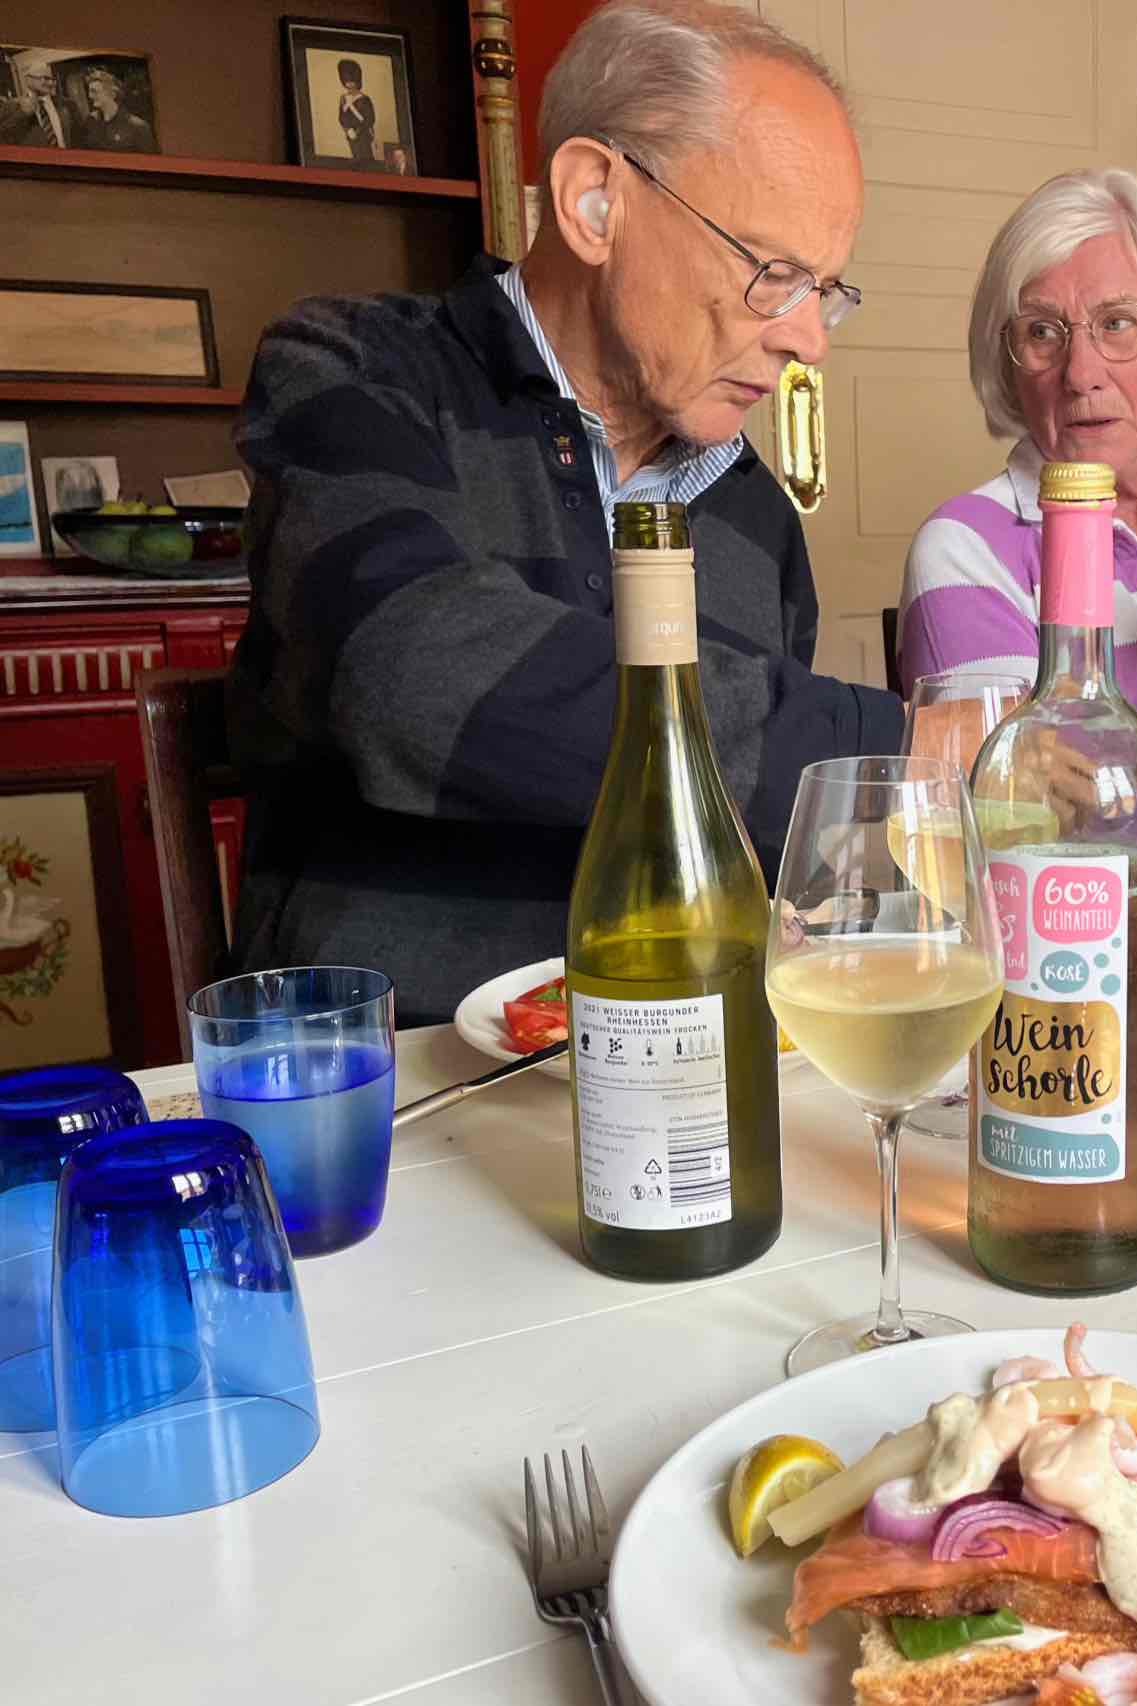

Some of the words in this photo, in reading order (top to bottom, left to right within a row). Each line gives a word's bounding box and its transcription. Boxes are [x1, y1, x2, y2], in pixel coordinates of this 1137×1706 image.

[1044, 878, 1109, 905] 60%
[1042, 907, 1112, 931] WEINANTEIL
[603, 1007, 640, 1018] WEISSER
[643, 1005, 700, 1018] BURGUNDER
[606, 1017, 669, 1027] RHEINHESSEN
[994, 1001, 1094, 1057] Wein
[991, 1125, 1017, 1141] mit
[989, 1138, 1053, 1170] SPRITZIGEM
[1057, 1148, 1108, 1170] WASSER
